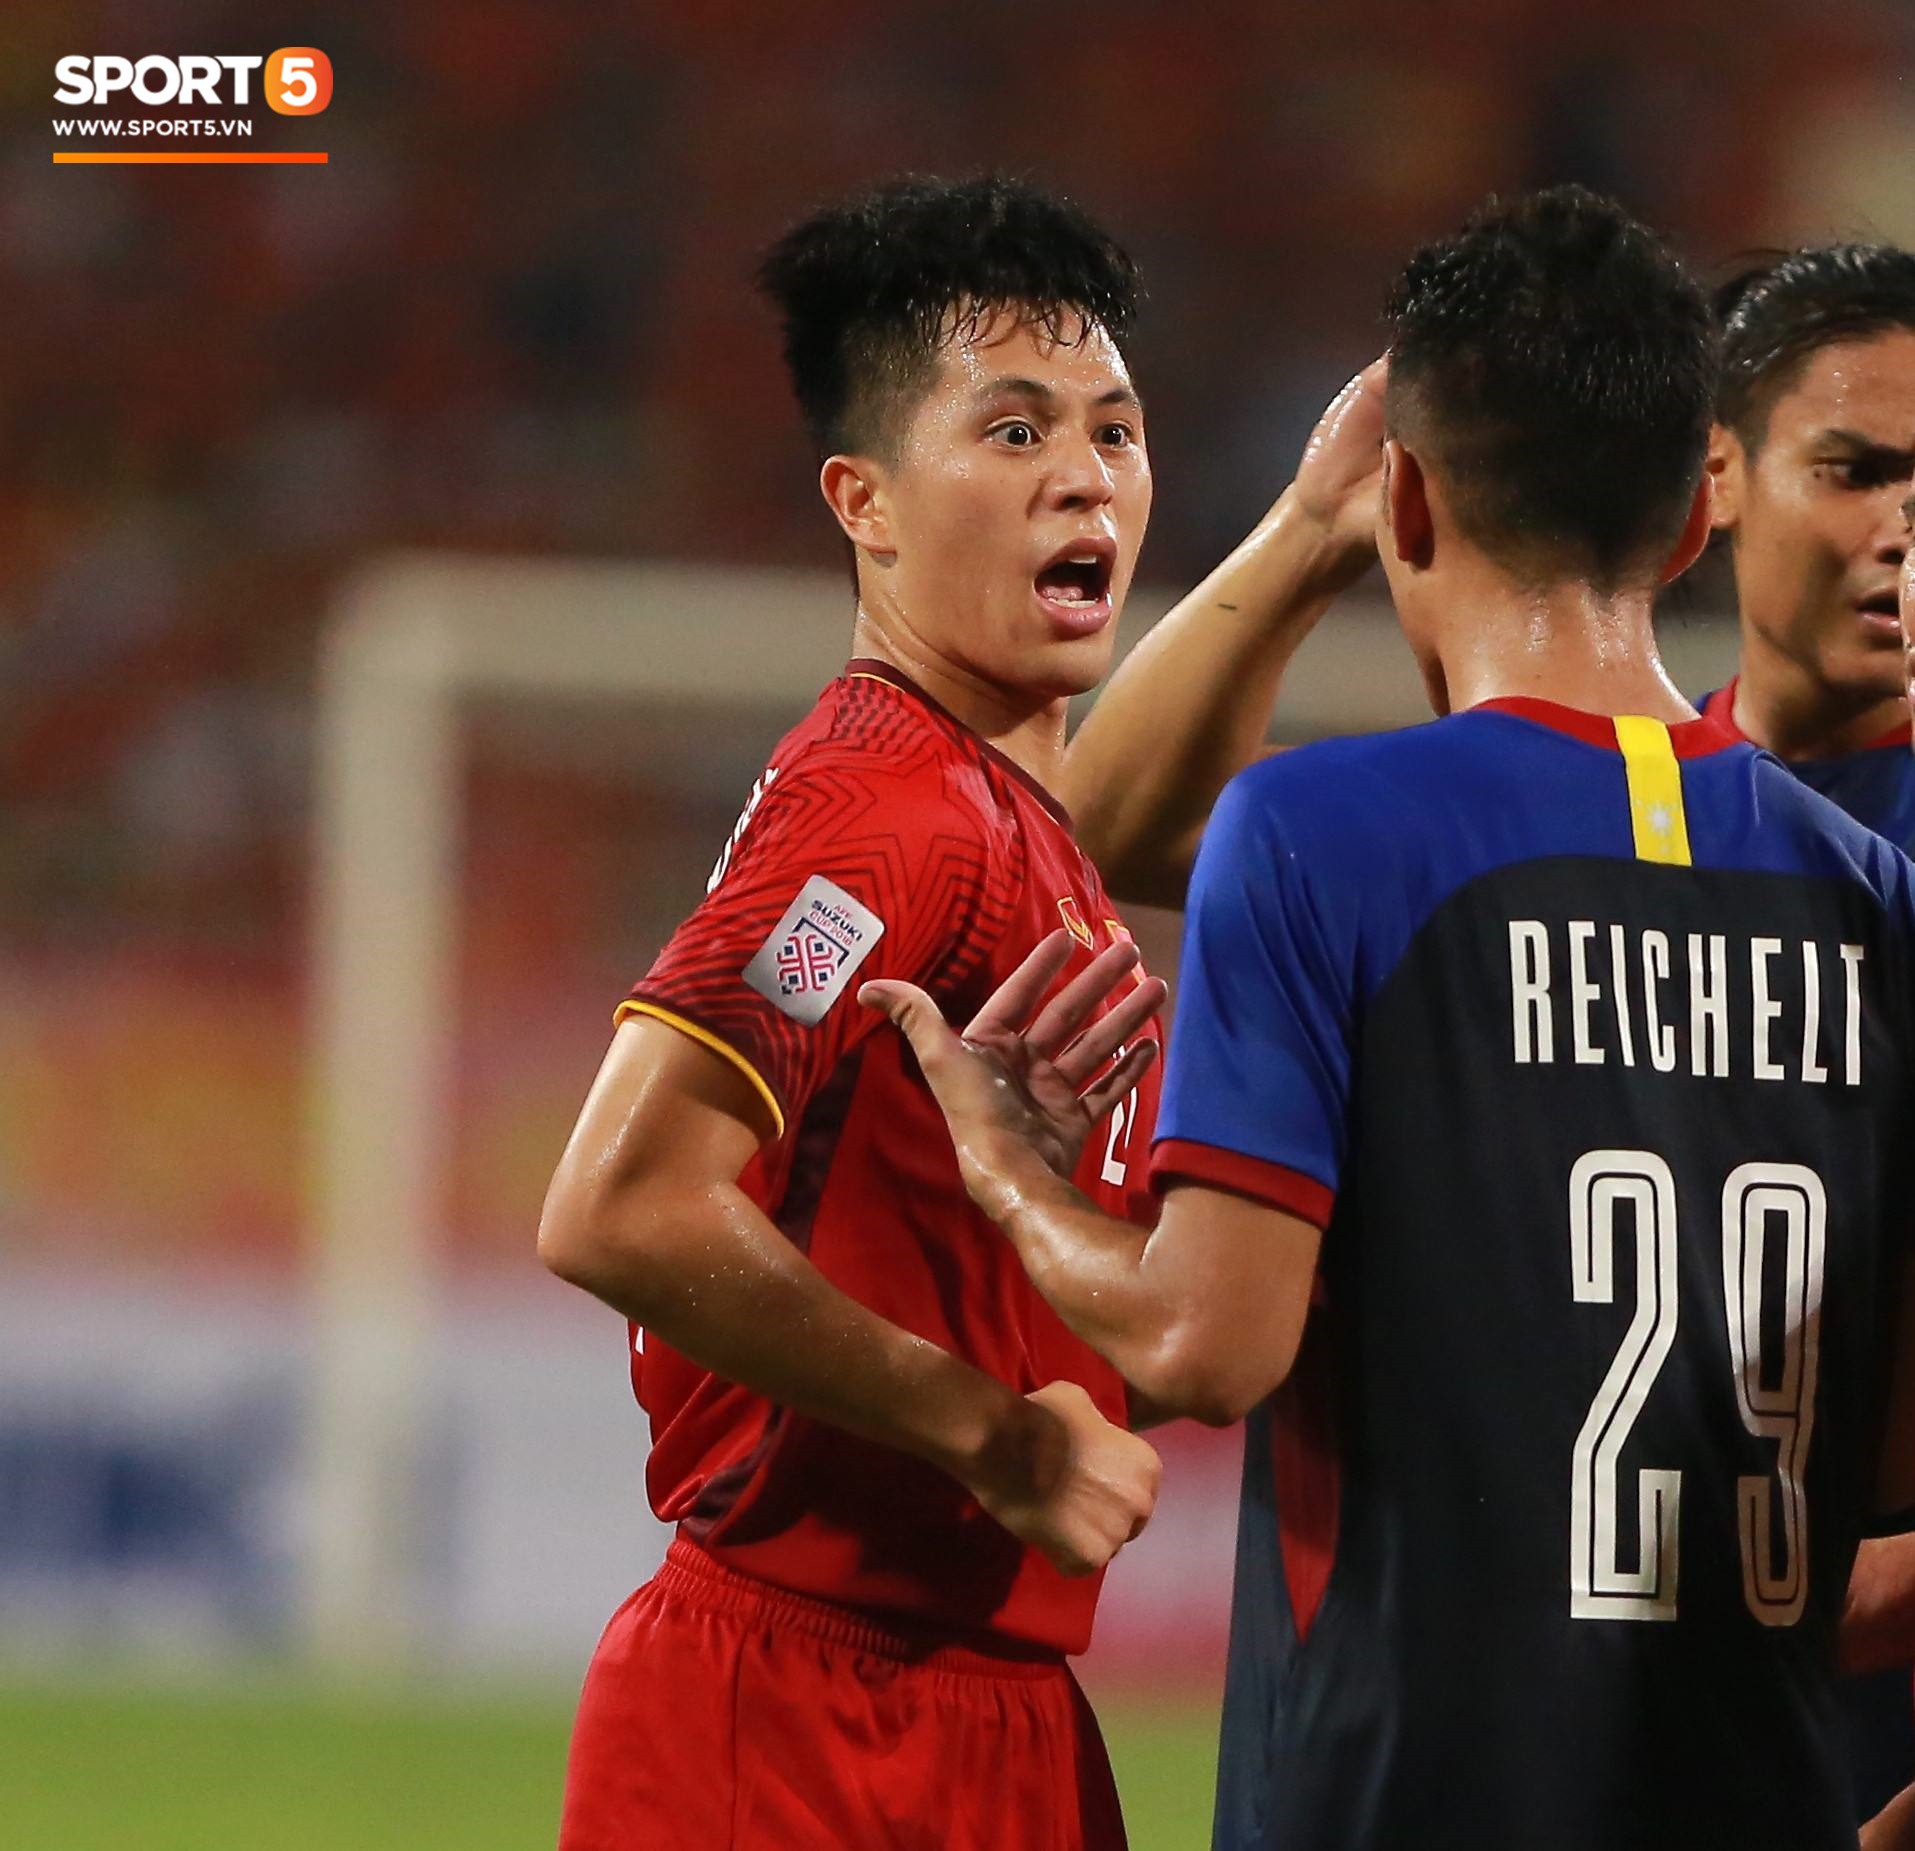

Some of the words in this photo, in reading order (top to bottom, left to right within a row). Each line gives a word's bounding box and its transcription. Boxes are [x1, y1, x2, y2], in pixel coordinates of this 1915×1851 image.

[809, 911, 830, 927] CUP
[811, 899, 863, 942] SUZUKI
[1508, 919, 1866, 1087] REICHELT
[1568, 1149, 1827, 1628] 29
